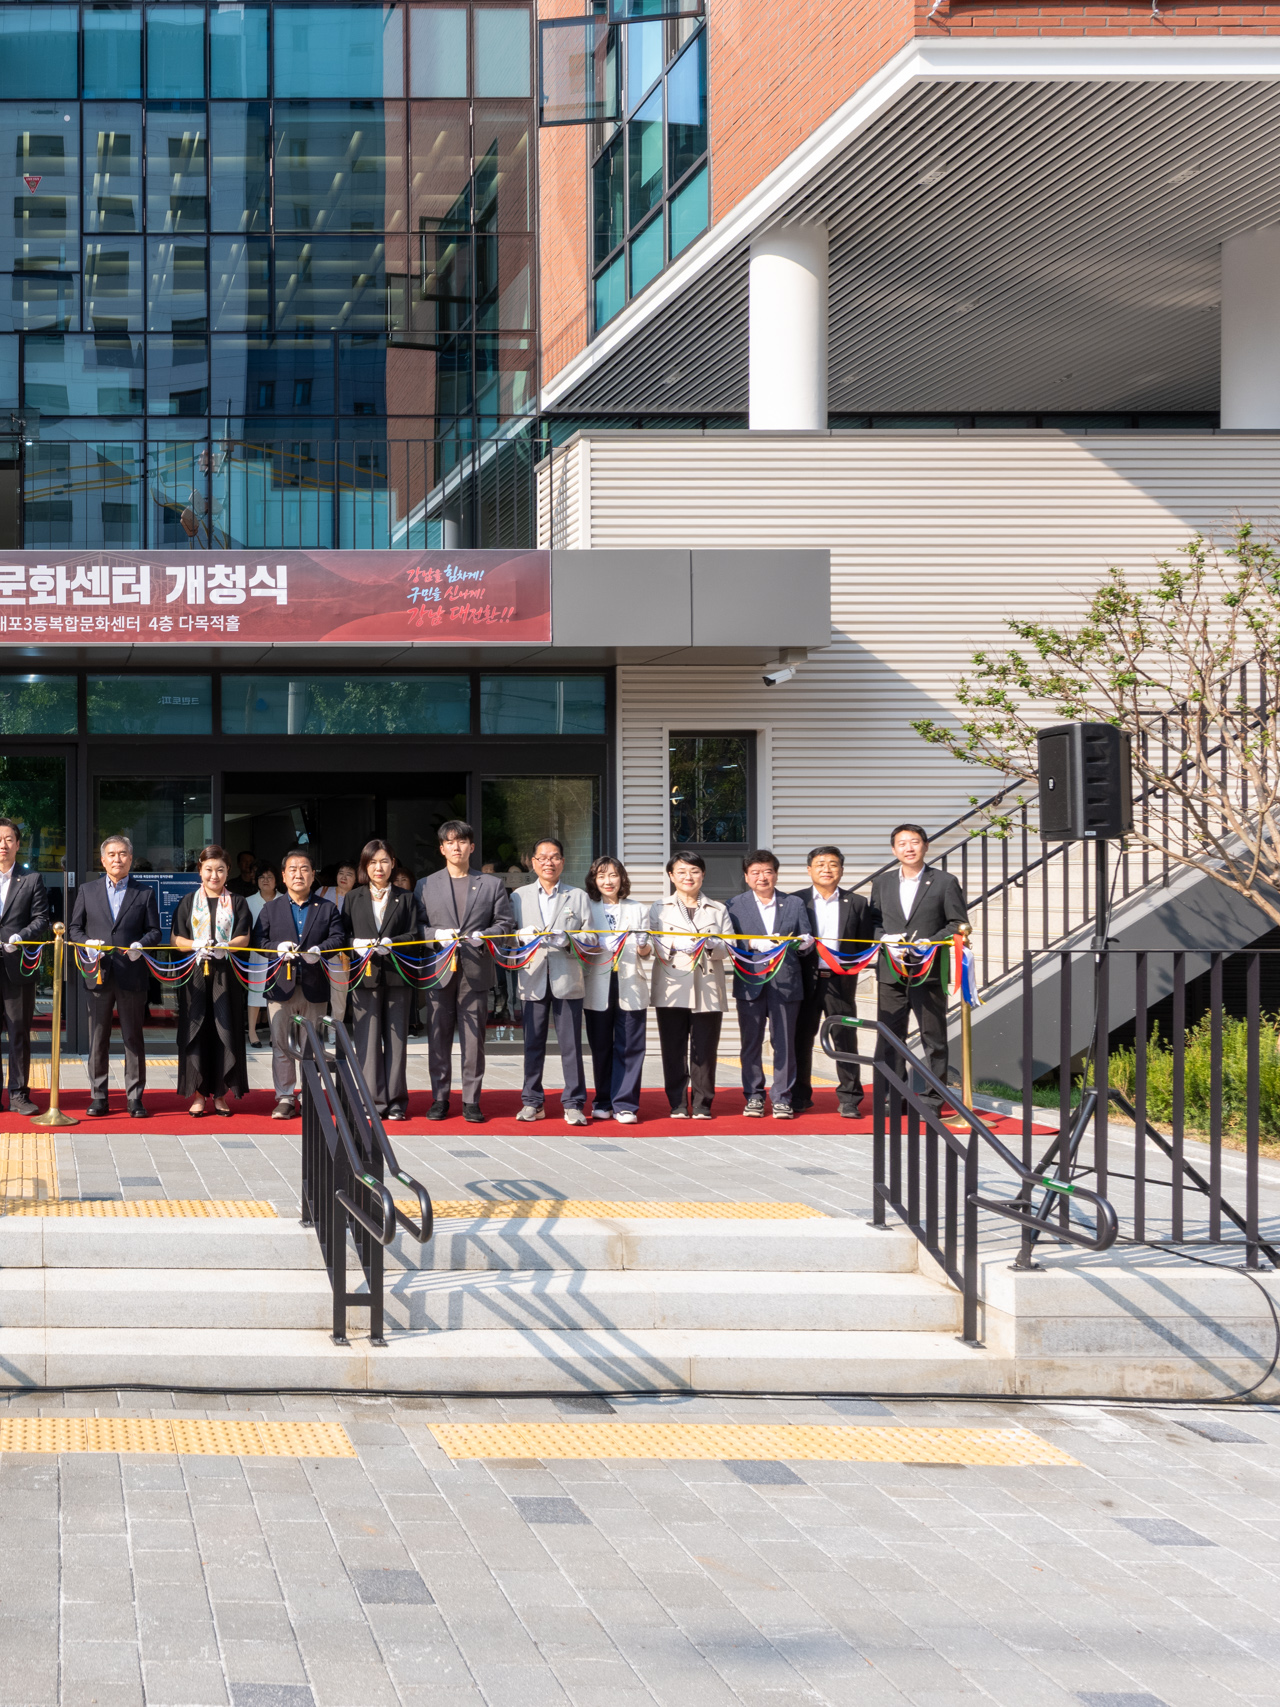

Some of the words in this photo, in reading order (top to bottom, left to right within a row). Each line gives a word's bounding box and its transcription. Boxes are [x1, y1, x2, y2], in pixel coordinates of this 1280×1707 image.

[406, 566, 443, 584] 강남을
[443, 563, 485, 583] 힘차게!
[166, 564, 288, 605] 개청식
[406, 586, 442, 604] 구민을
[443, 584, 486, 601] 신나게!
[148, 616, 174, 632] 4층
[179, 615, 241, 632] 다목적홀
[407, 603, 445, 627] 강남
[449, 602, 515, 625] 대전환!!
